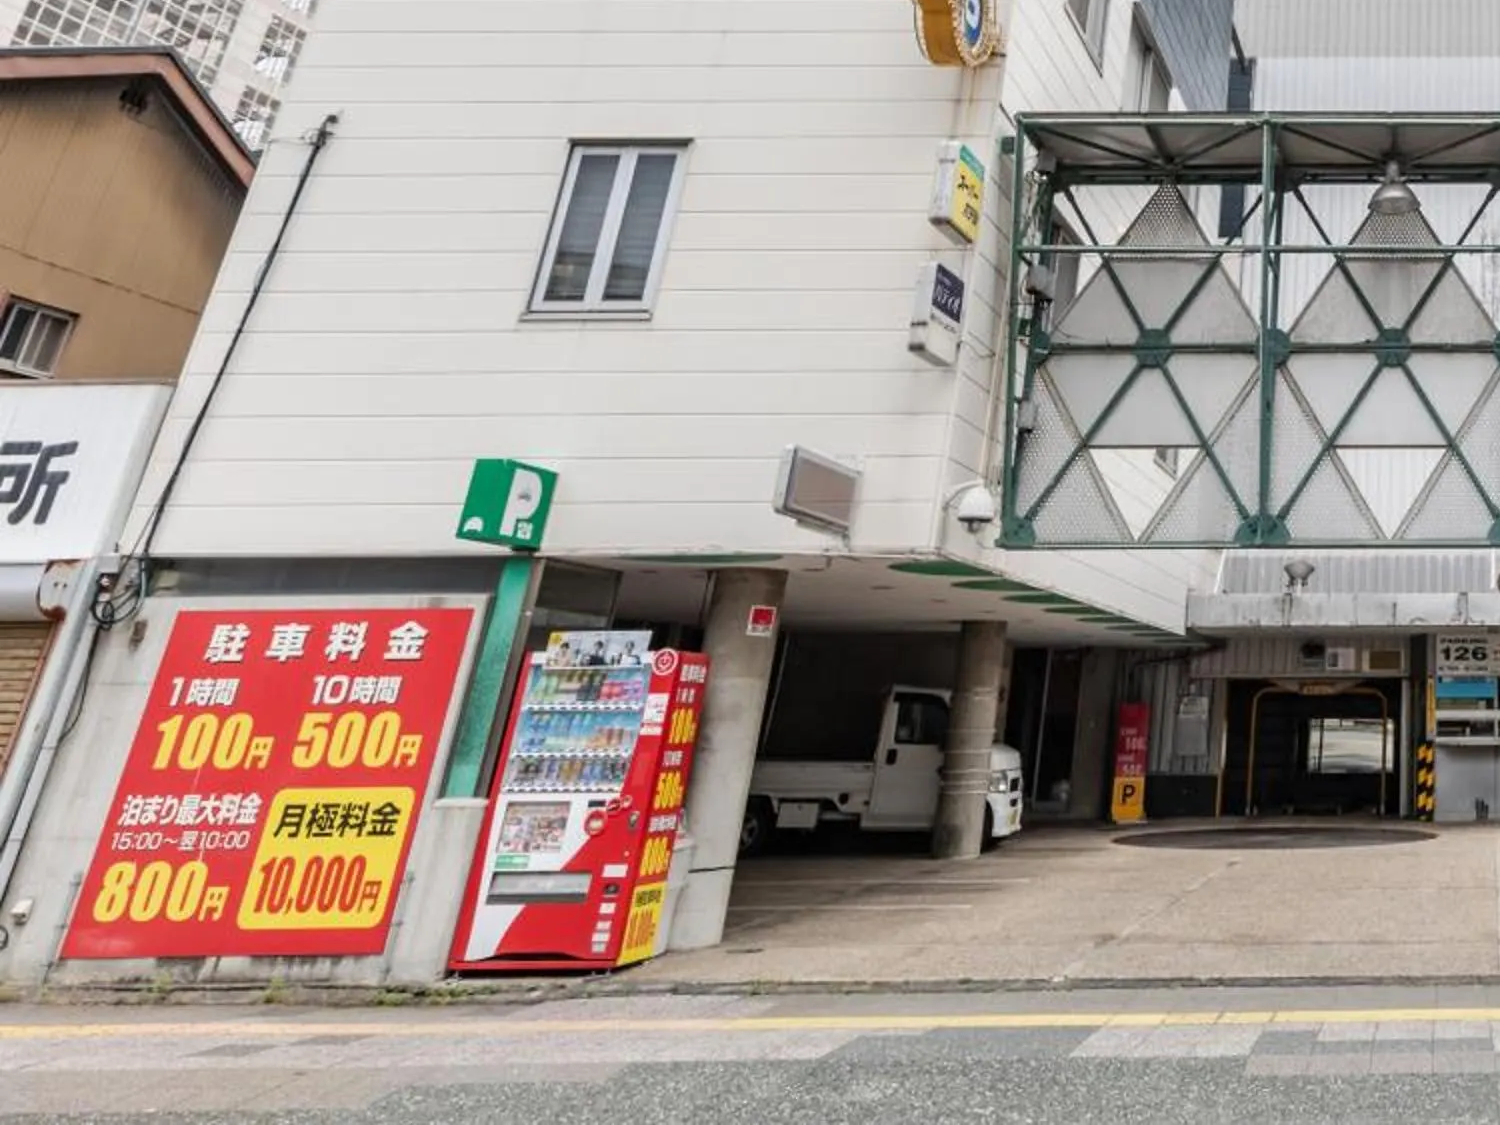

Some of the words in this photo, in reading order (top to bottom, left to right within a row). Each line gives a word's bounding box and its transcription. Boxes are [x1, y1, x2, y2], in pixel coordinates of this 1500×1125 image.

[499, 467, 543, 537] P
[203, 621, 429, 664] 駐車料金
[1441, 645, 1488, 662] 126
[168, 676, 240, 707] 1時間
[310, 674, 402, 706] 10時間
[151, 712, 275, 772] 100円
[291, 710, 423, 770] 500円
[117, 791, 263, 826] 泊まり最大料金
[273, 801, 402, 839] 月極料金
[92, 859, 230, 925] 800円
[251, 853, 383, 916] 10,000円
